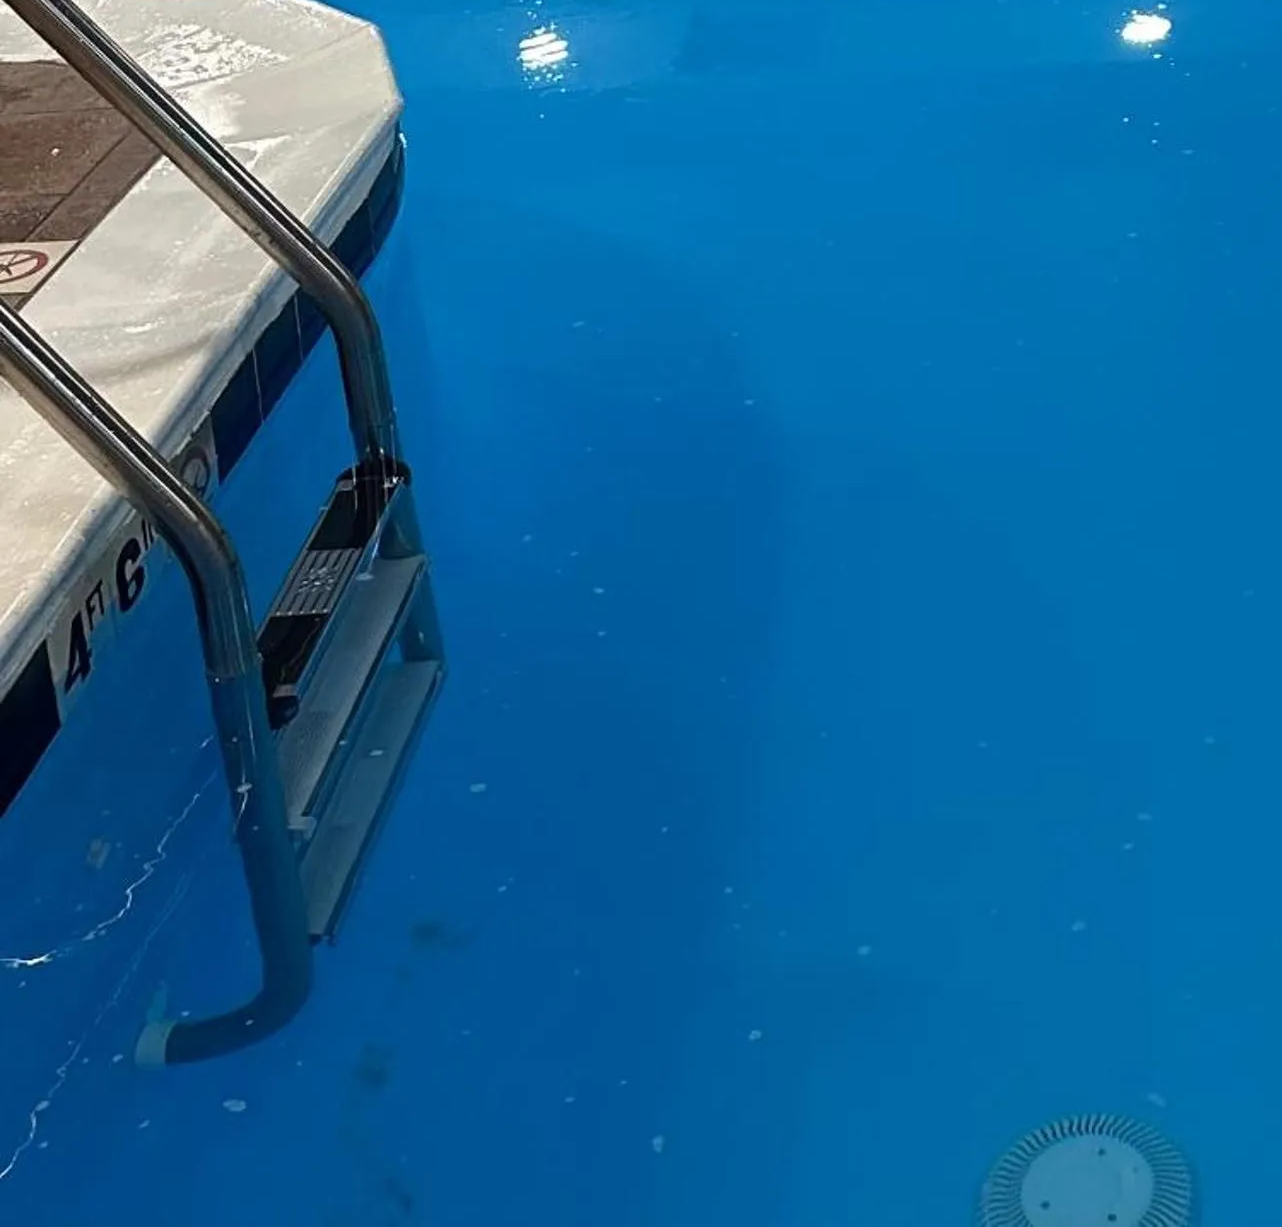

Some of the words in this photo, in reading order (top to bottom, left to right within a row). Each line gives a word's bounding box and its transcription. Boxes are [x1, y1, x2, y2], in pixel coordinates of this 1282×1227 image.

[64, 611, 93, 695] 4
[85, 579, 105, 632] FT
[116, 537, 145, 613] 6
